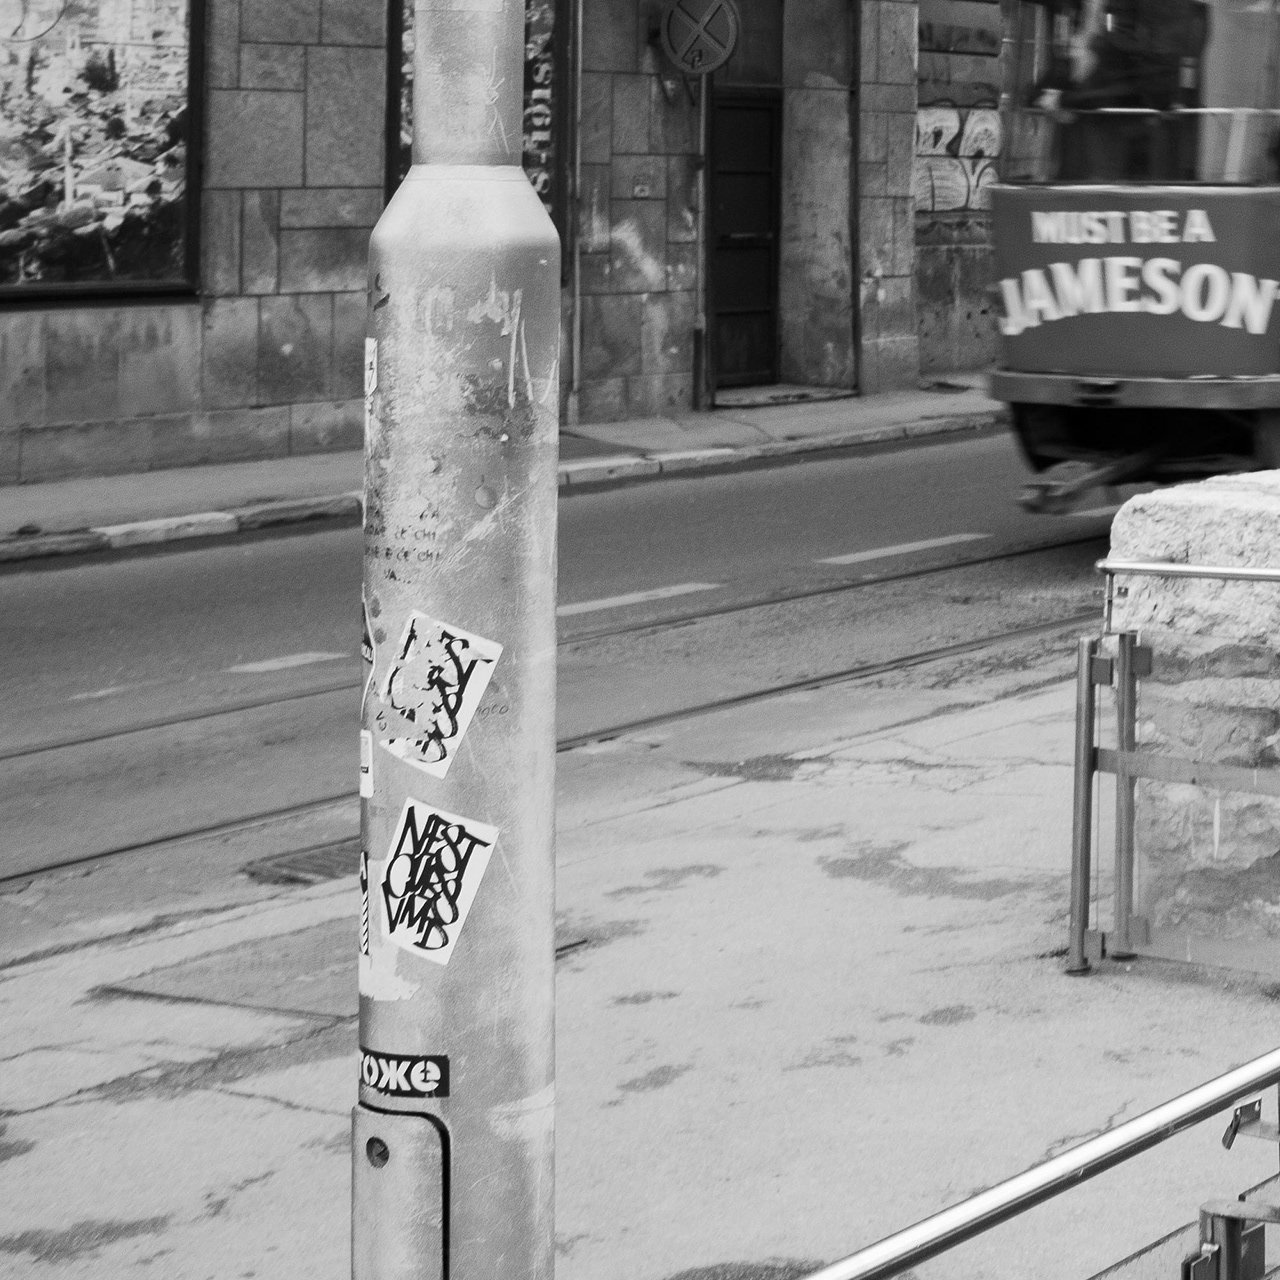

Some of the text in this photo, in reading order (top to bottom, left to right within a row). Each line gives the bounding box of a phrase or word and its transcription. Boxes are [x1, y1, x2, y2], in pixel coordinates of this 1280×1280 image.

[1031, 209, 1217, 244] MUST BE A
[998, 256, 1280, 336] JAMESON
